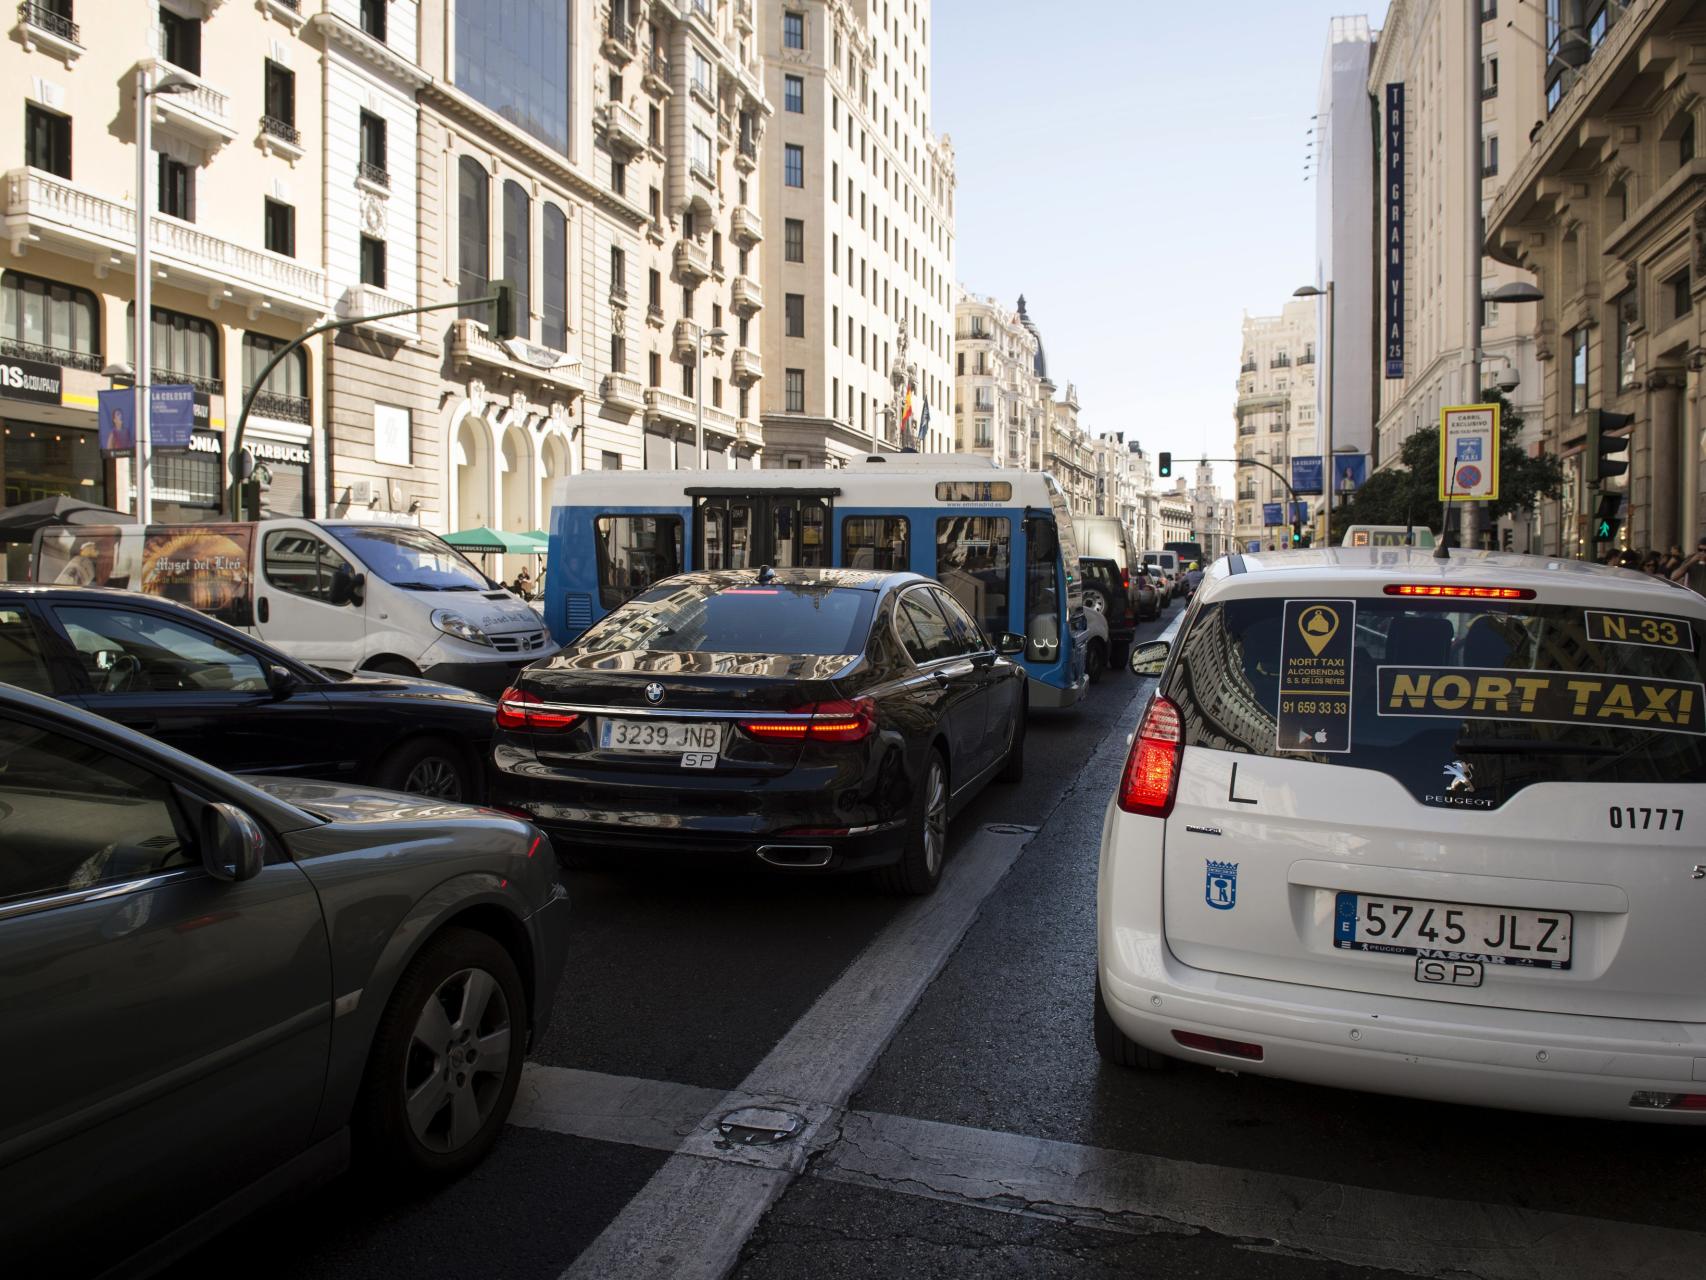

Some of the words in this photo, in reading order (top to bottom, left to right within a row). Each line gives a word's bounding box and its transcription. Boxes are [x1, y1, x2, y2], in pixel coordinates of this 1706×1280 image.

[1391, 88, 1400, 168] TRYP
[1391, 184, 1400, 265] GRAN
[1389, 345, 1401, 357] 25
[152, 392, 160, 400] LA
[161, 392, 192, 400] CELESTE
[1602, 615, 1679, 645] N-33
[1287, 668, 1345, 676] ALCOBENDAS
[1289, 658, 1318, 666] NORT
[1321, 658, 1344, 666] TAXI
[1283, 701, 1294, 713] 91
[1297, 701, 1316, 714] 659
[1318, 702, 1331, 714] 33
[1333, 702, 1347, 715] 33
[1390, 674, 1550, 713] NORT
[1567, 680, 1693, 724] TAXI
[616, 725, 669, 745] 3239
[676, 727, 717, 748] JNB
[685, 754, 713, 767] SP
[1229, 762, 1257, 804] L
[1425, 795, 1494, 807] PEUGEOT
[1609, 806, 1684, 831] 01777
[1342, 921, 1349, 931] E
[1365, 902, 1466, 945] 5745
[1483, 914, 1559, 953] JLZ
[1369, 944, 1407, 953] PEUGEOT
[1416, 948, 1507, 964] NASCAR
[1424, 963, 1475, 983] SP
